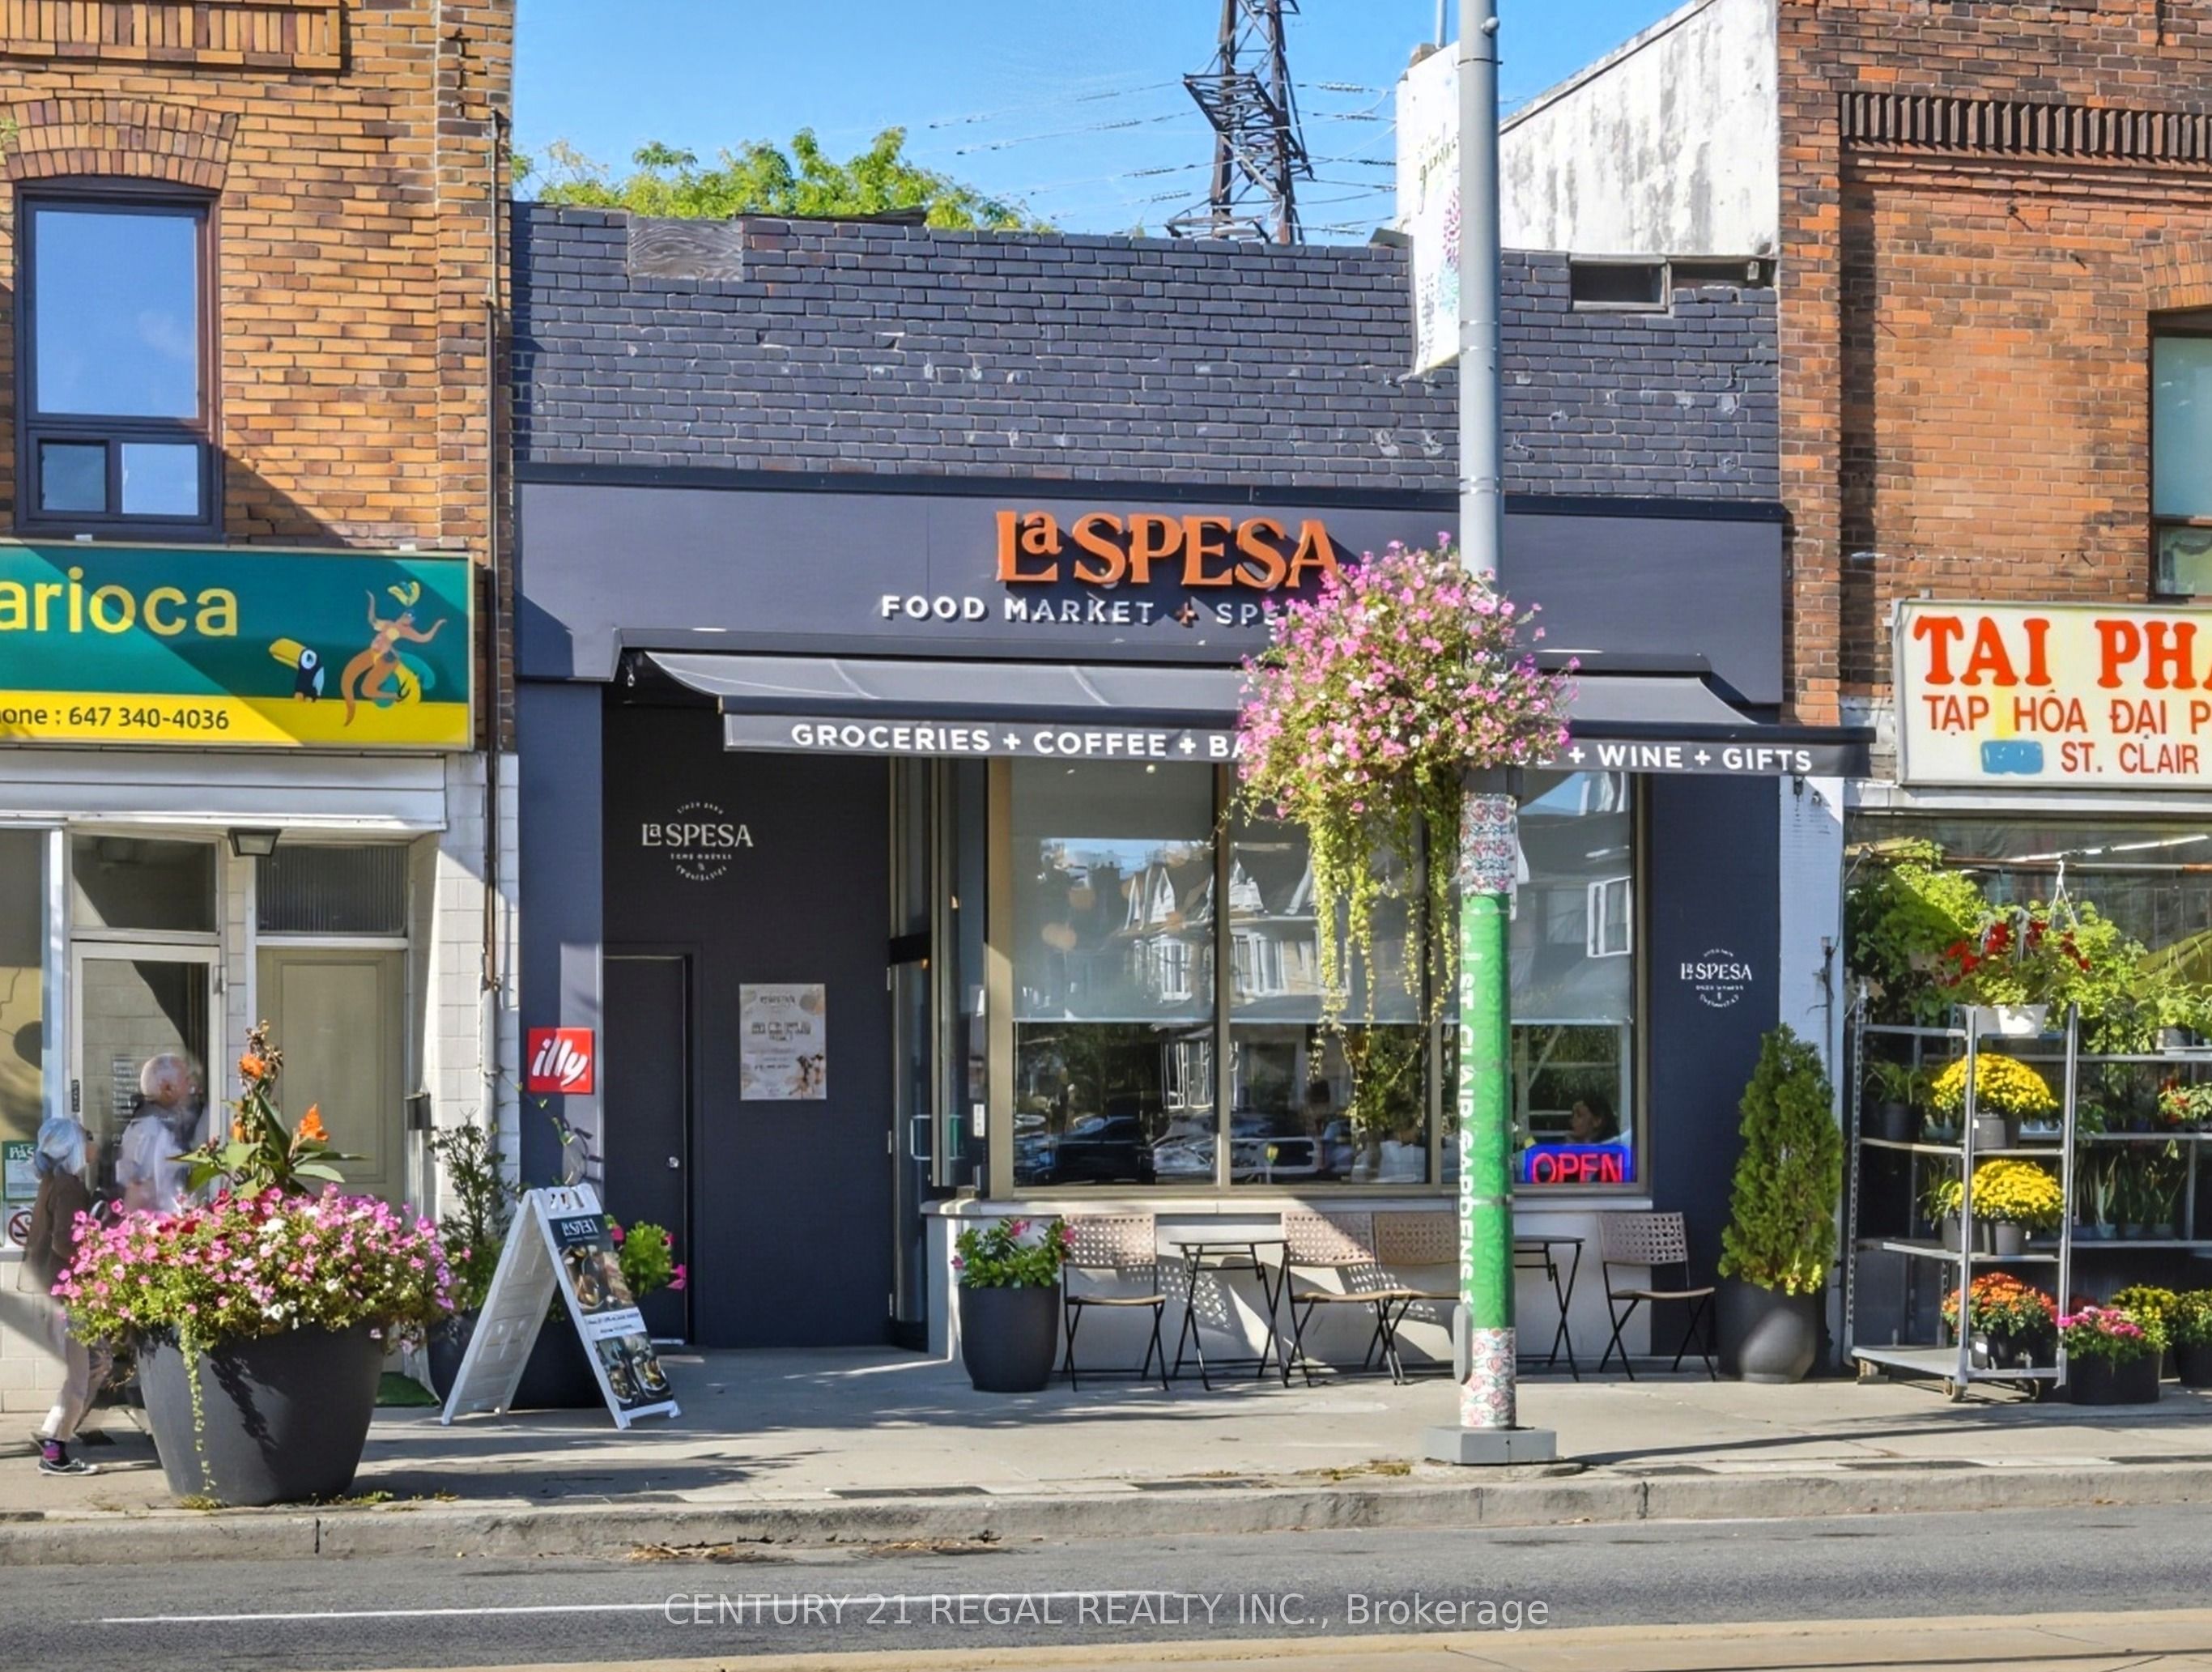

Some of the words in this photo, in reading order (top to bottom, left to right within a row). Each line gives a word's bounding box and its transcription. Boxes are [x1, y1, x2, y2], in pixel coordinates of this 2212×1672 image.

[1072, 513, 1342, 589] SPESA
[881, 594, 985, 619] FOOD
[1004, 598, 1155, 623] MARKET
[1912, 615, 2053, 688] TAI
[2094, 619, 2212, 692] PH
[0, 708, 48, 725] one
[69, 707, 111, 726] 647
[118, 708, 229, 730] 340-4036
[791, 723, 991, 751] GROCERIES
[1033, 730, 1167, 757] COFFEE
[1597, 743, 1683, 768] WINE
[1722, 747, 1813, 772] GIFTS
[2061, 741, 2103, 772] ST.
[2119, 742, 2199, 773] CLAIR
[666, 823, 754, 847] SPESA
[531, 1036, 588, 1087] illy
[1531, 1152, 1623, 1184] OPEN
